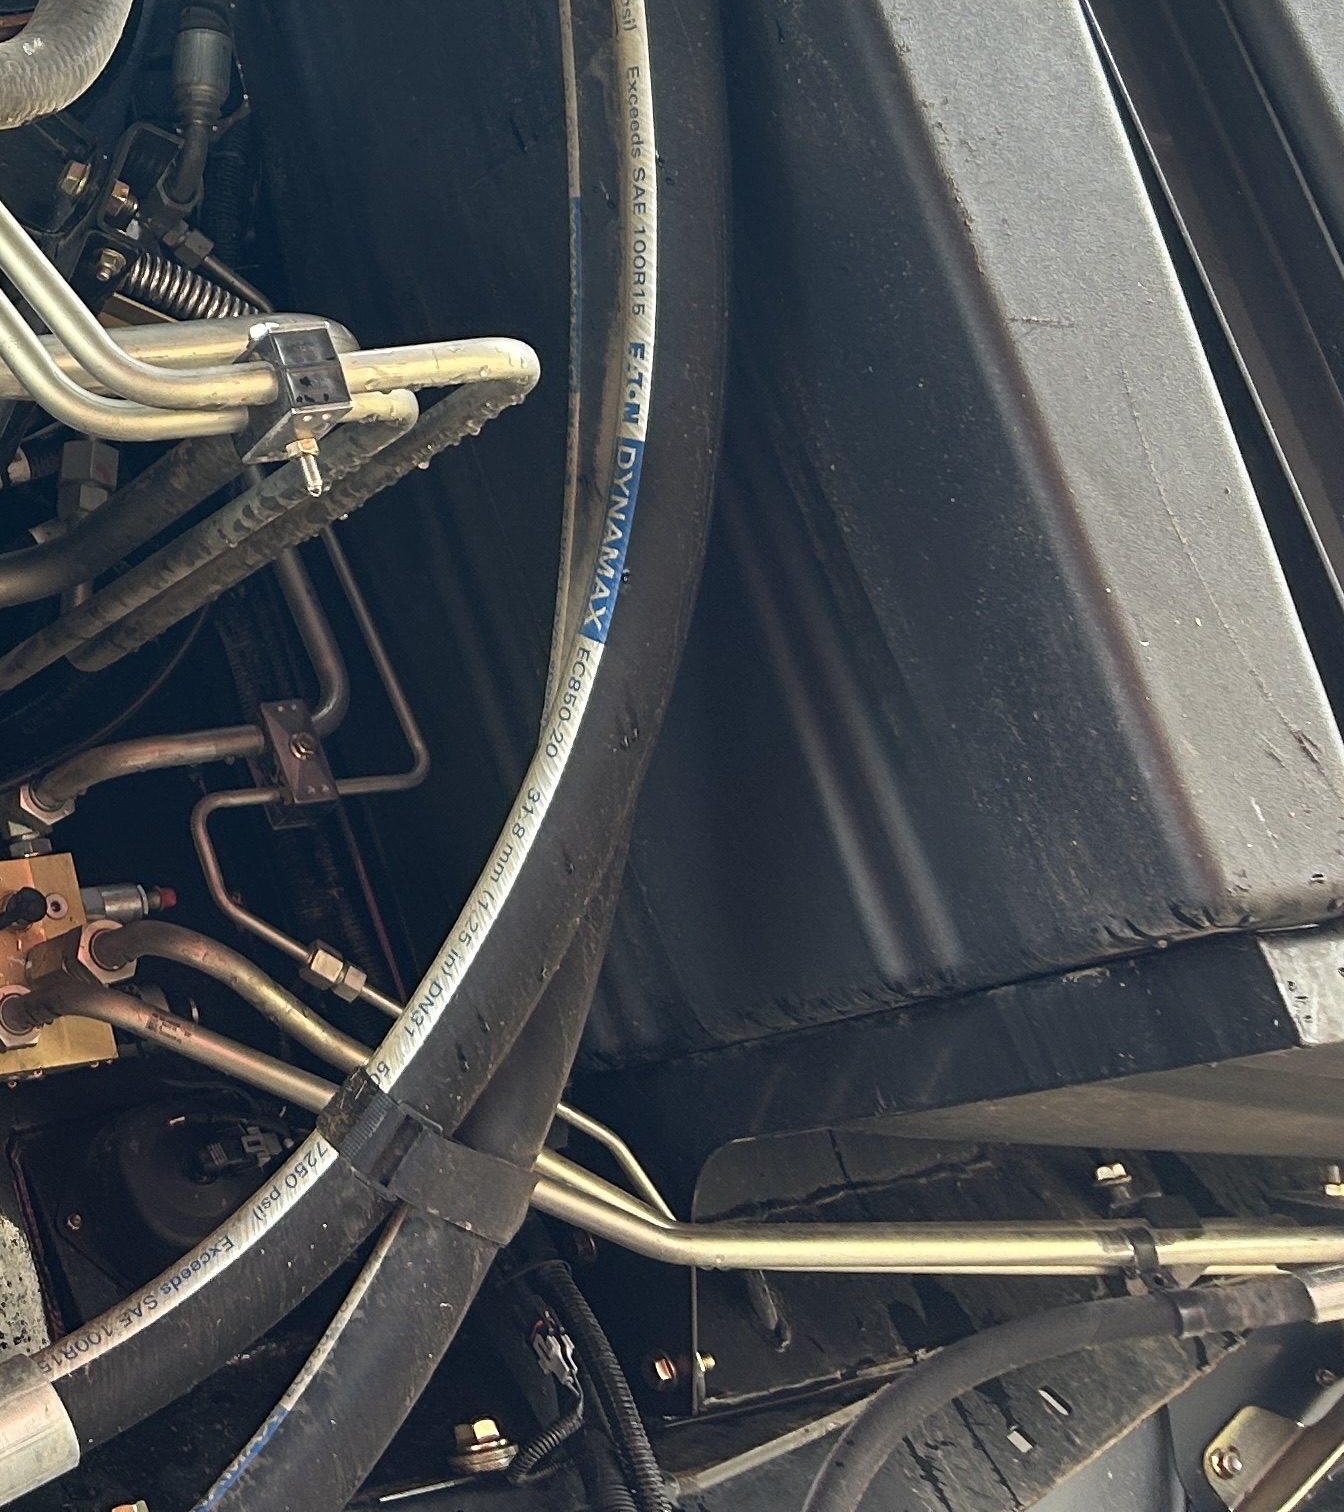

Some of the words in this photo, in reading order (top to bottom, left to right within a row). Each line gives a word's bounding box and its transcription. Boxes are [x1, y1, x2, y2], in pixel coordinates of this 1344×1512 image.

[626, 65, 643, 160] Exceeds
[632, 166, 647, 215] SAE
[631, 225, 648, 317] 100R15
[582, 444, 637, 631] DYNAMAX
[489, 845, 515, 884] mm
[402, 982, 445, 1038] DN31
[251, 1187, 283, 1223] psi)
[158, 1234, 235, 1297] Exceeds
[120, 1293, 159, 1332] SAE
